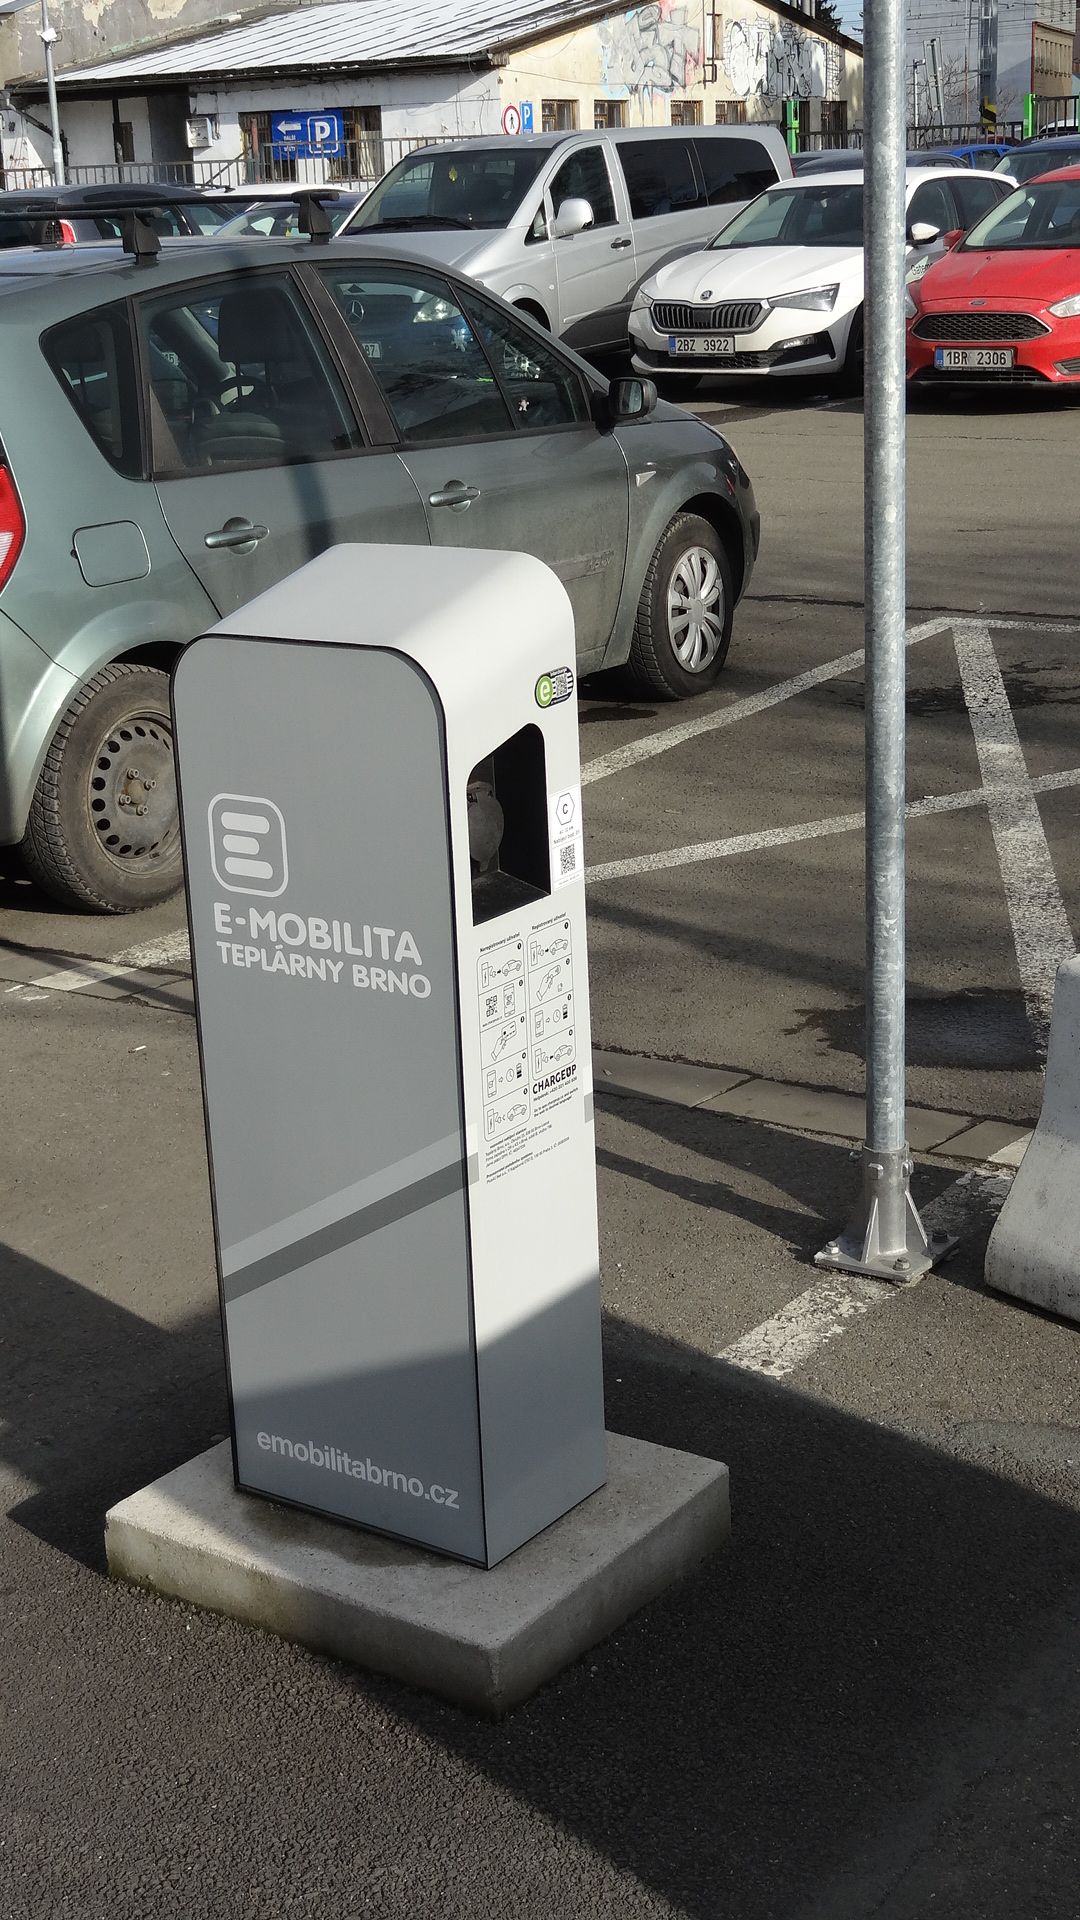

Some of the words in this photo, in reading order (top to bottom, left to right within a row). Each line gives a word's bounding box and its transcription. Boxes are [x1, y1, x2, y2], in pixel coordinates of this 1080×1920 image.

[524, 106, 531, 125] P
[315, 121, 331, 148] P
[677, 338, 696, 352] 2BZ
[703, 338, 729, 352] 3922
[946, 351, 968, 366] 1BR
[977, 351, 1007, 366] 2306
[213, 902, 423, 966] E-MOBILITA
[217, 940, 345, 984] TEPLÁRNY
[353, 964, 432, 999] BRNO
[532, 1063, 577, 1095] CHARGEUP
[257, 1430, 460, 1510] emobilitabrno.cz
